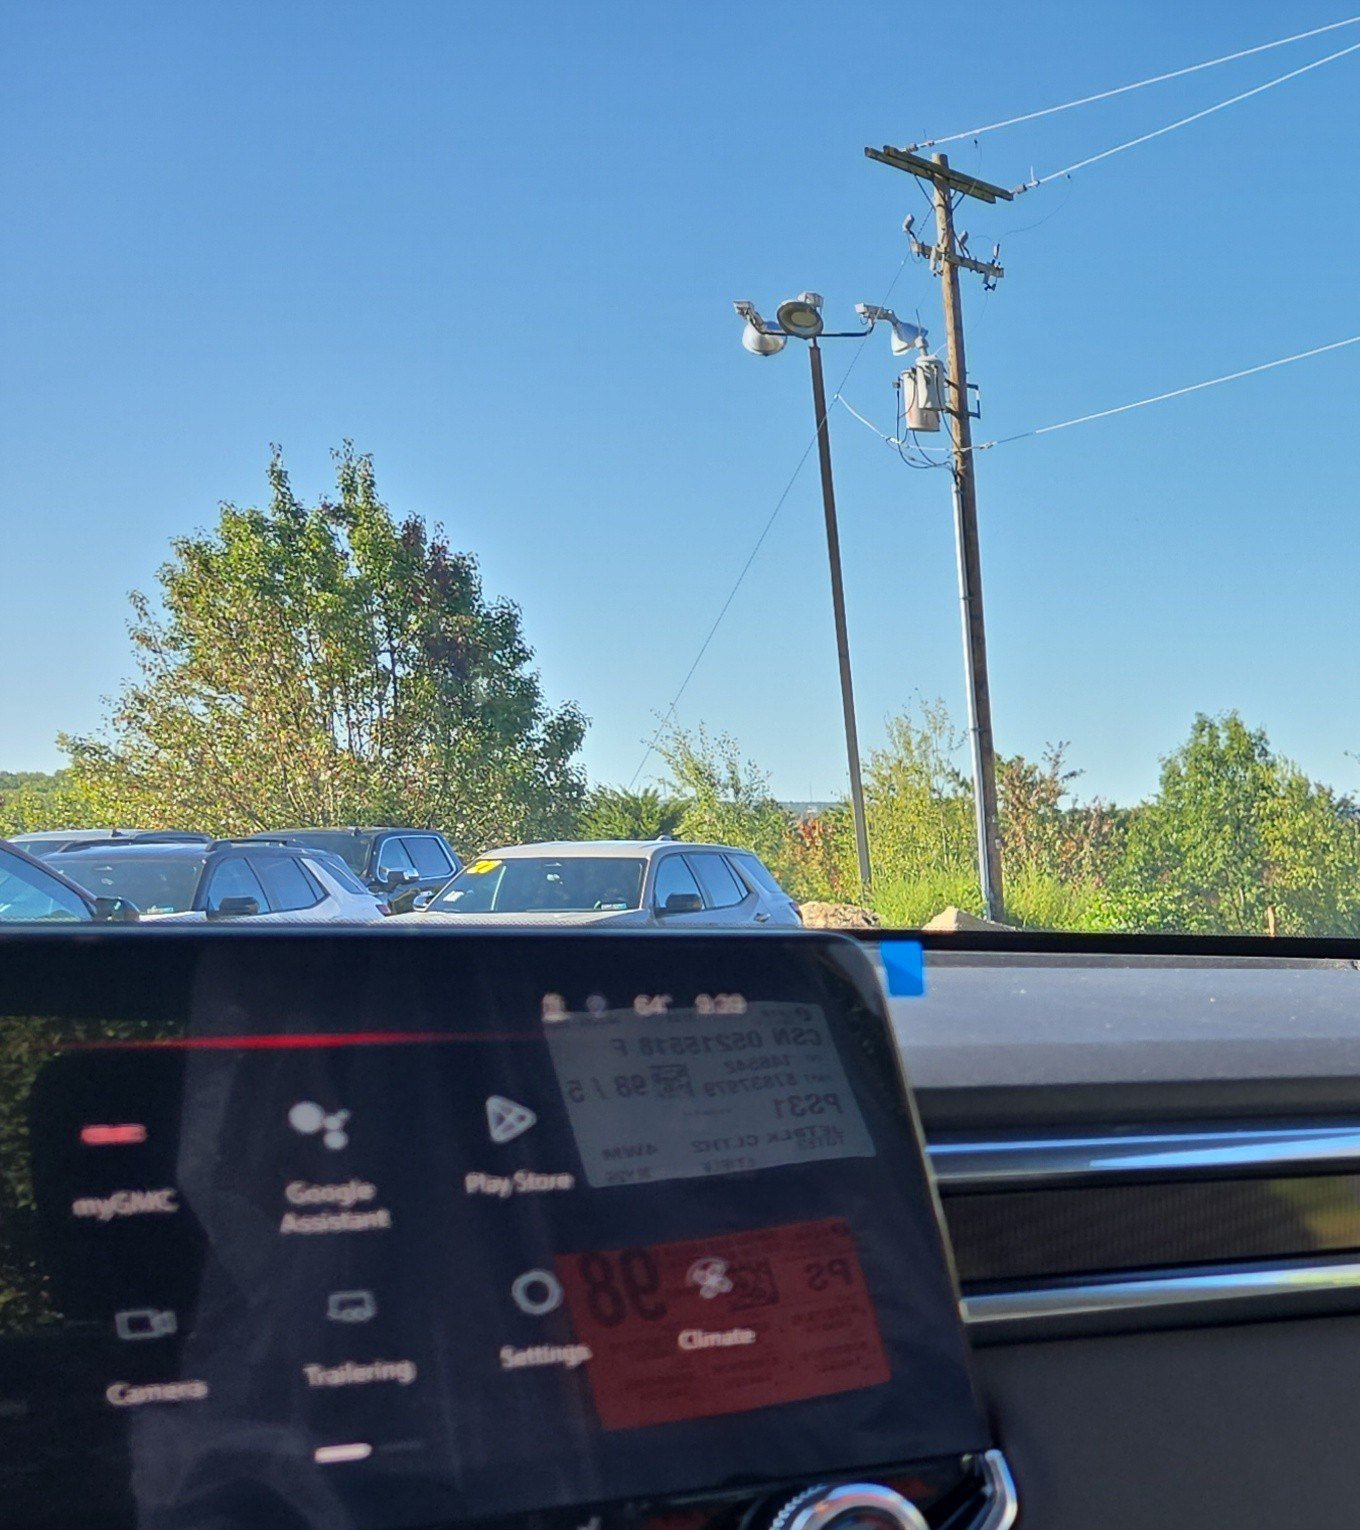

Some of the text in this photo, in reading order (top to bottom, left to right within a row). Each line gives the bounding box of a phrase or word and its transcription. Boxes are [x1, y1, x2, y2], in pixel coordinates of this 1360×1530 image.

[285, 1179, 377, 1207] Google
[464, 1170, 575, 1198] Play Store
[280, 1207, 393, 1236] Assistant
[678, 1327, 756, 1351] Climate
[500, 1342, 593, 1370] Settings
[303, 1359, 417, 1388] Trailering
[106, 1380, 209, 1406] Camera
